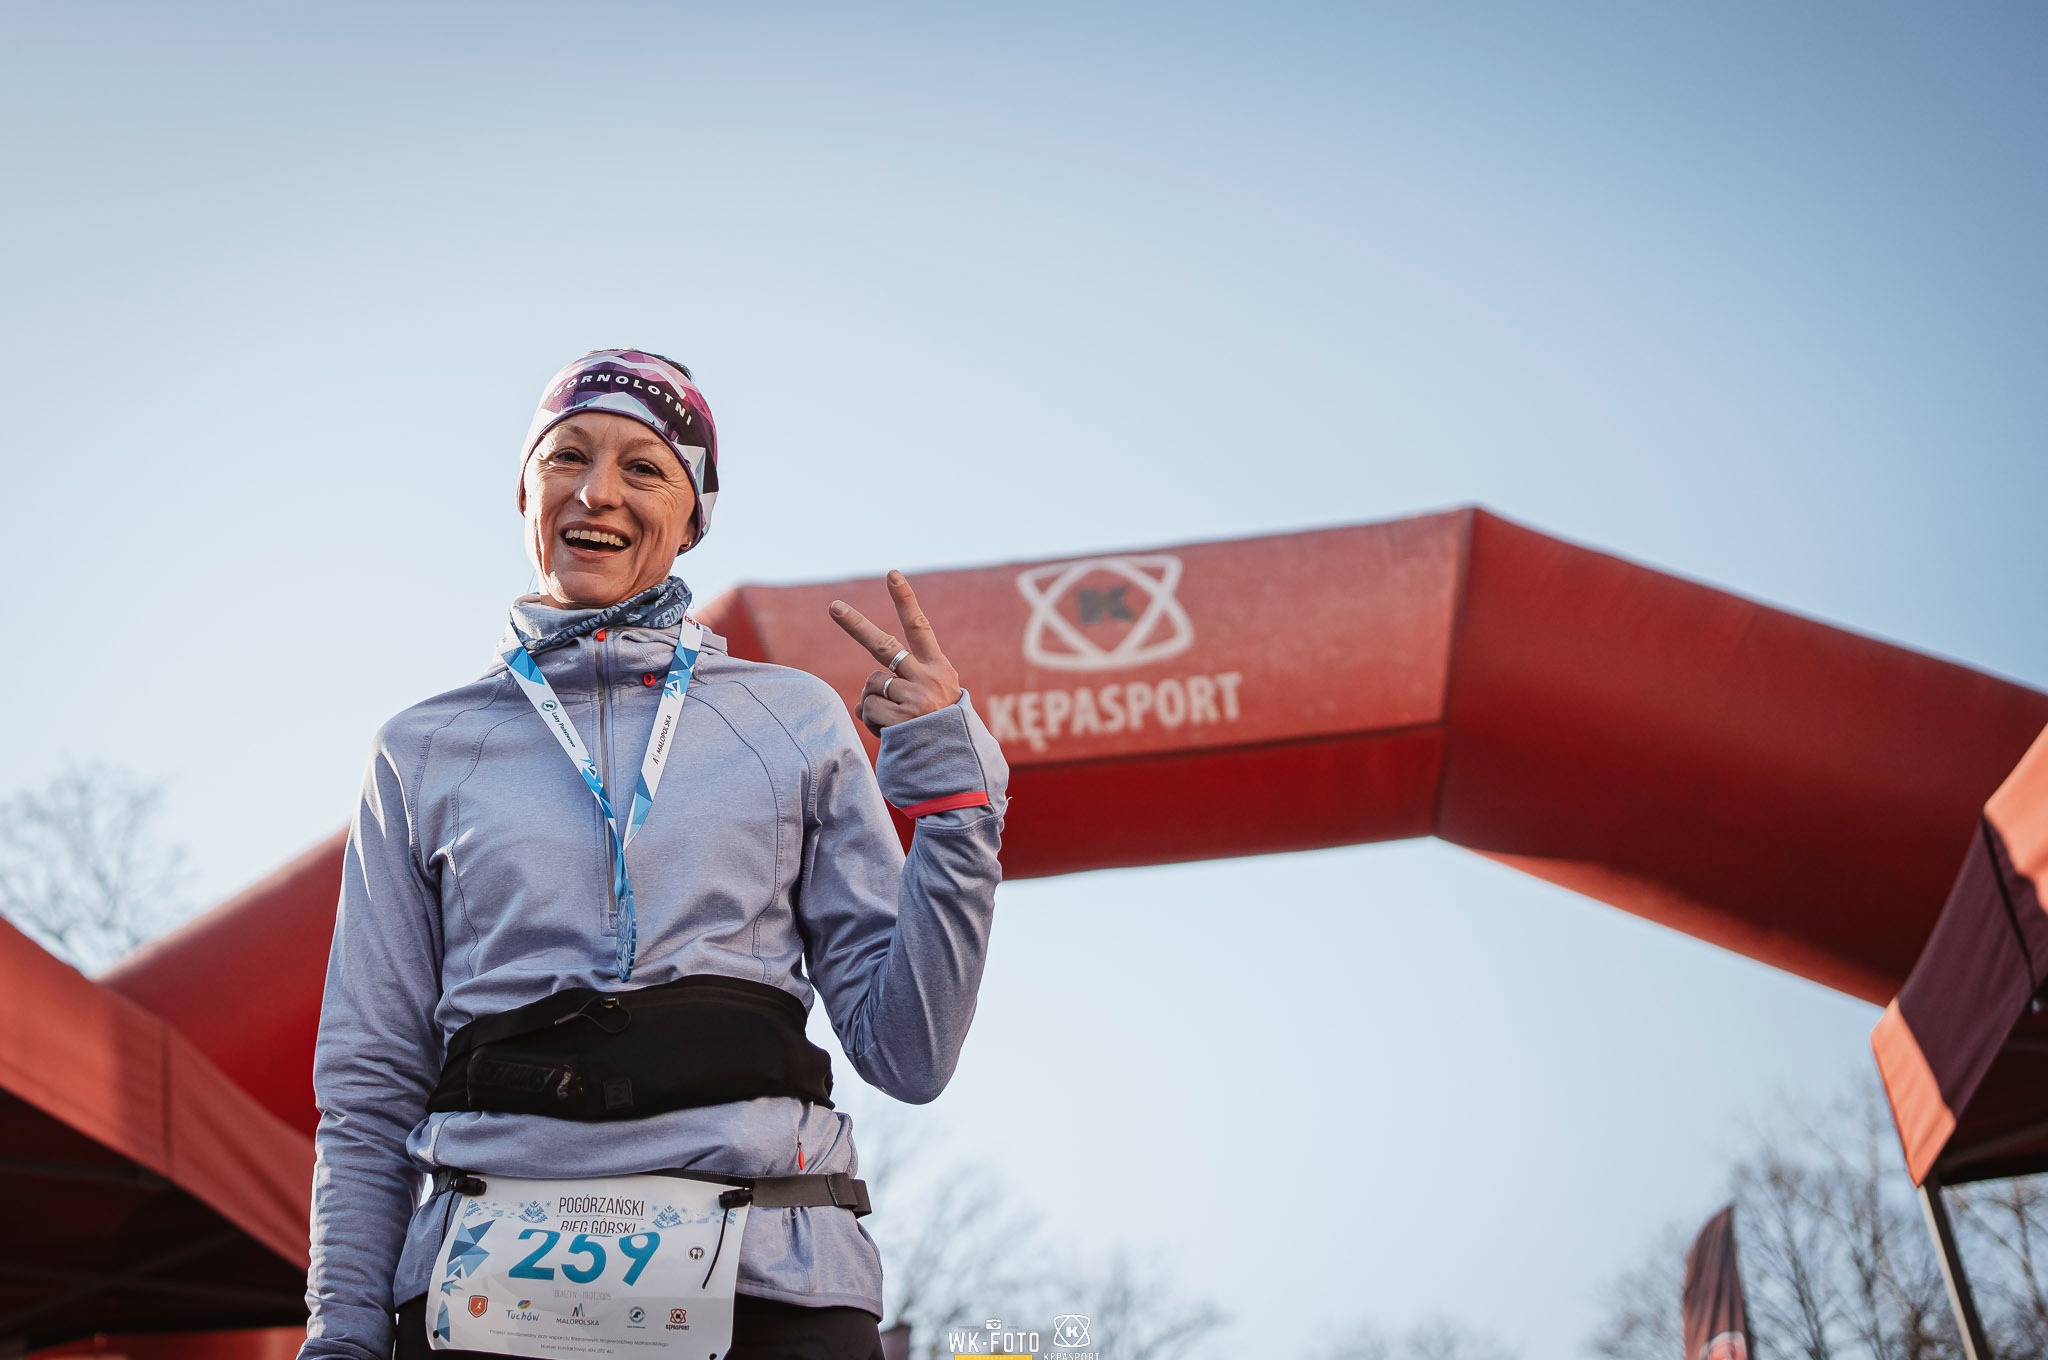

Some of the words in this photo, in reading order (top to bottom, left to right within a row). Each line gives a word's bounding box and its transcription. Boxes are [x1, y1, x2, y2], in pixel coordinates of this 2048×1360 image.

[1076, 585, 1136, 624] K
[988, 671, 1243, 752] KĘPASPORT
[558, 1194, 645, 1217] POGÓRZAŃSKI
[560, 1220, 588, 1233] BIEG
[590, 1218, 637, 1234] GÓRSKI
[508, 1228, 661, 1287] 259
[505, 1309, 540, 1322] Tuchów
